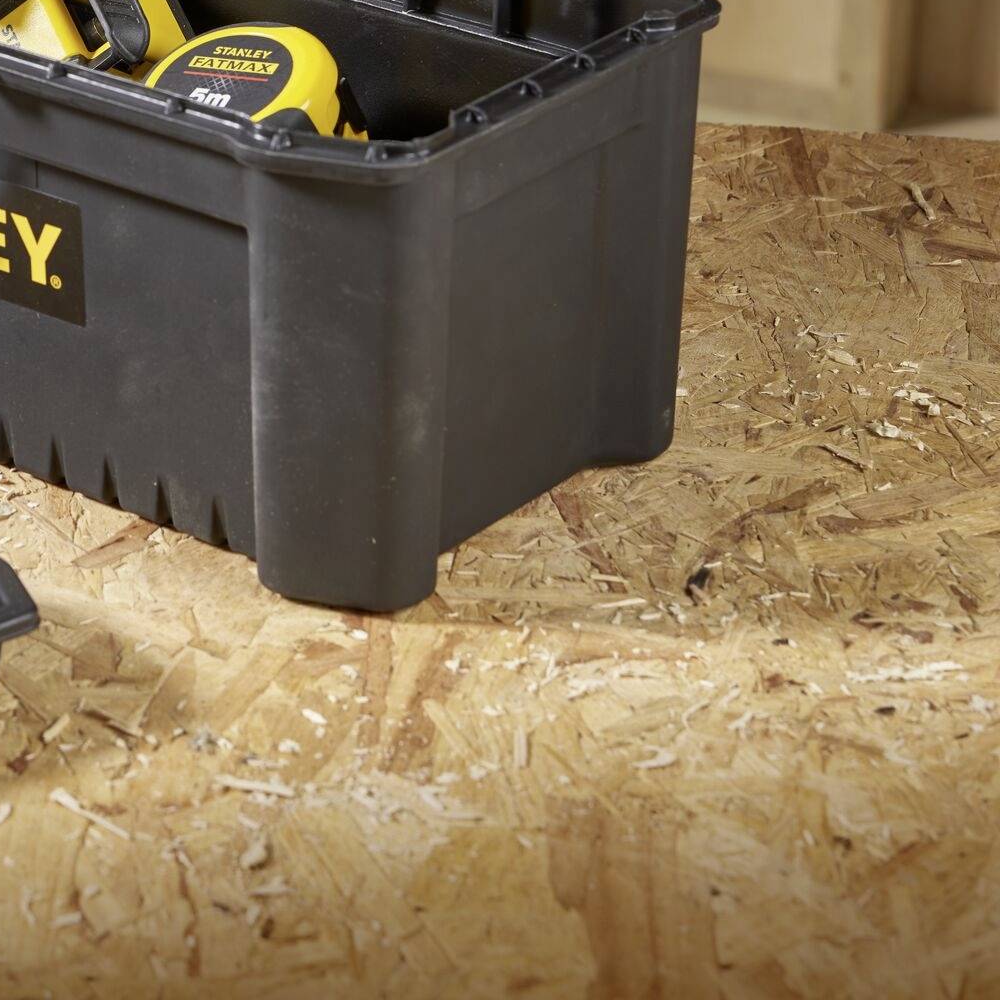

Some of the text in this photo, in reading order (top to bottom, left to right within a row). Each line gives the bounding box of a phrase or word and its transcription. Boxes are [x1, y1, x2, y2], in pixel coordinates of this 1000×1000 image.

[213, 46, 273, 59] STANLEY
[192, 57, 272, 73] FATMAX
[188, 87, 232, 108] 5m
